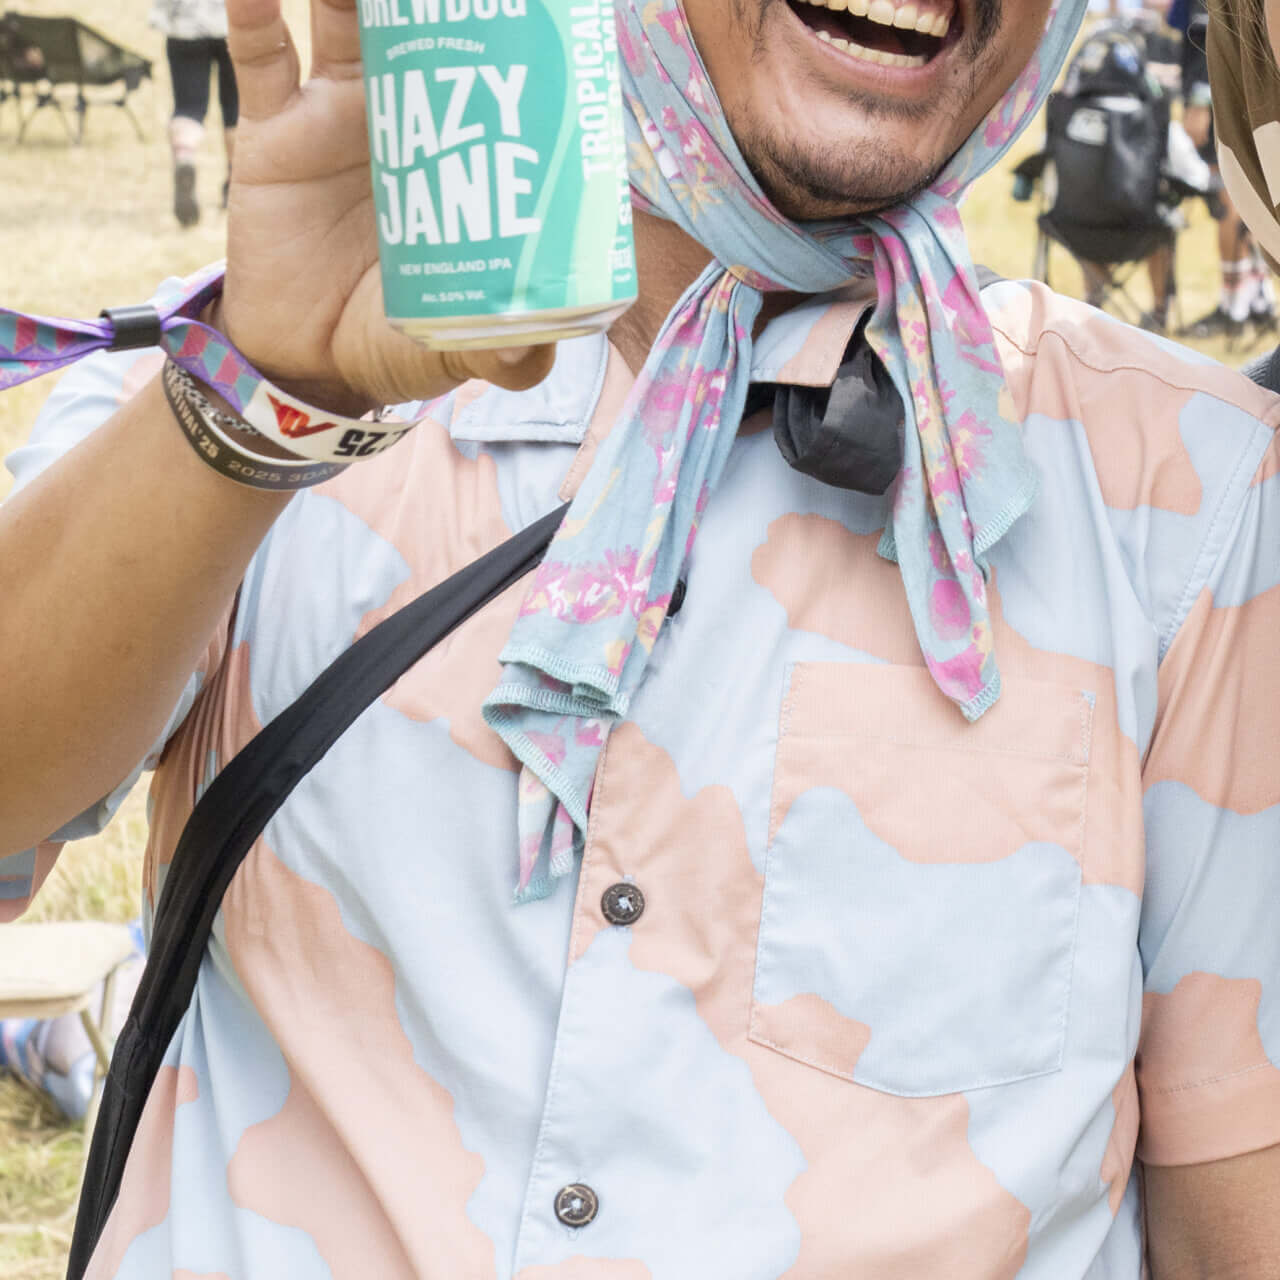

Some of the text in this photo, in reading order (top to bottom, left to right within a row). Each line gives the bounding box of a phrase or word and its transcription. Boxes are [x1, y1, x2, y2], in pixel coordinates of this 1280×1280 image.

[386, 36, 486, 61] BREWED FRESH
[369, 64, 529, 170] HAZY
[380, 141, 541, 246] JANE
[400, 257, 513, 276] NEW ENGLAND IPA
[226, 459, 282, 483] 2025
